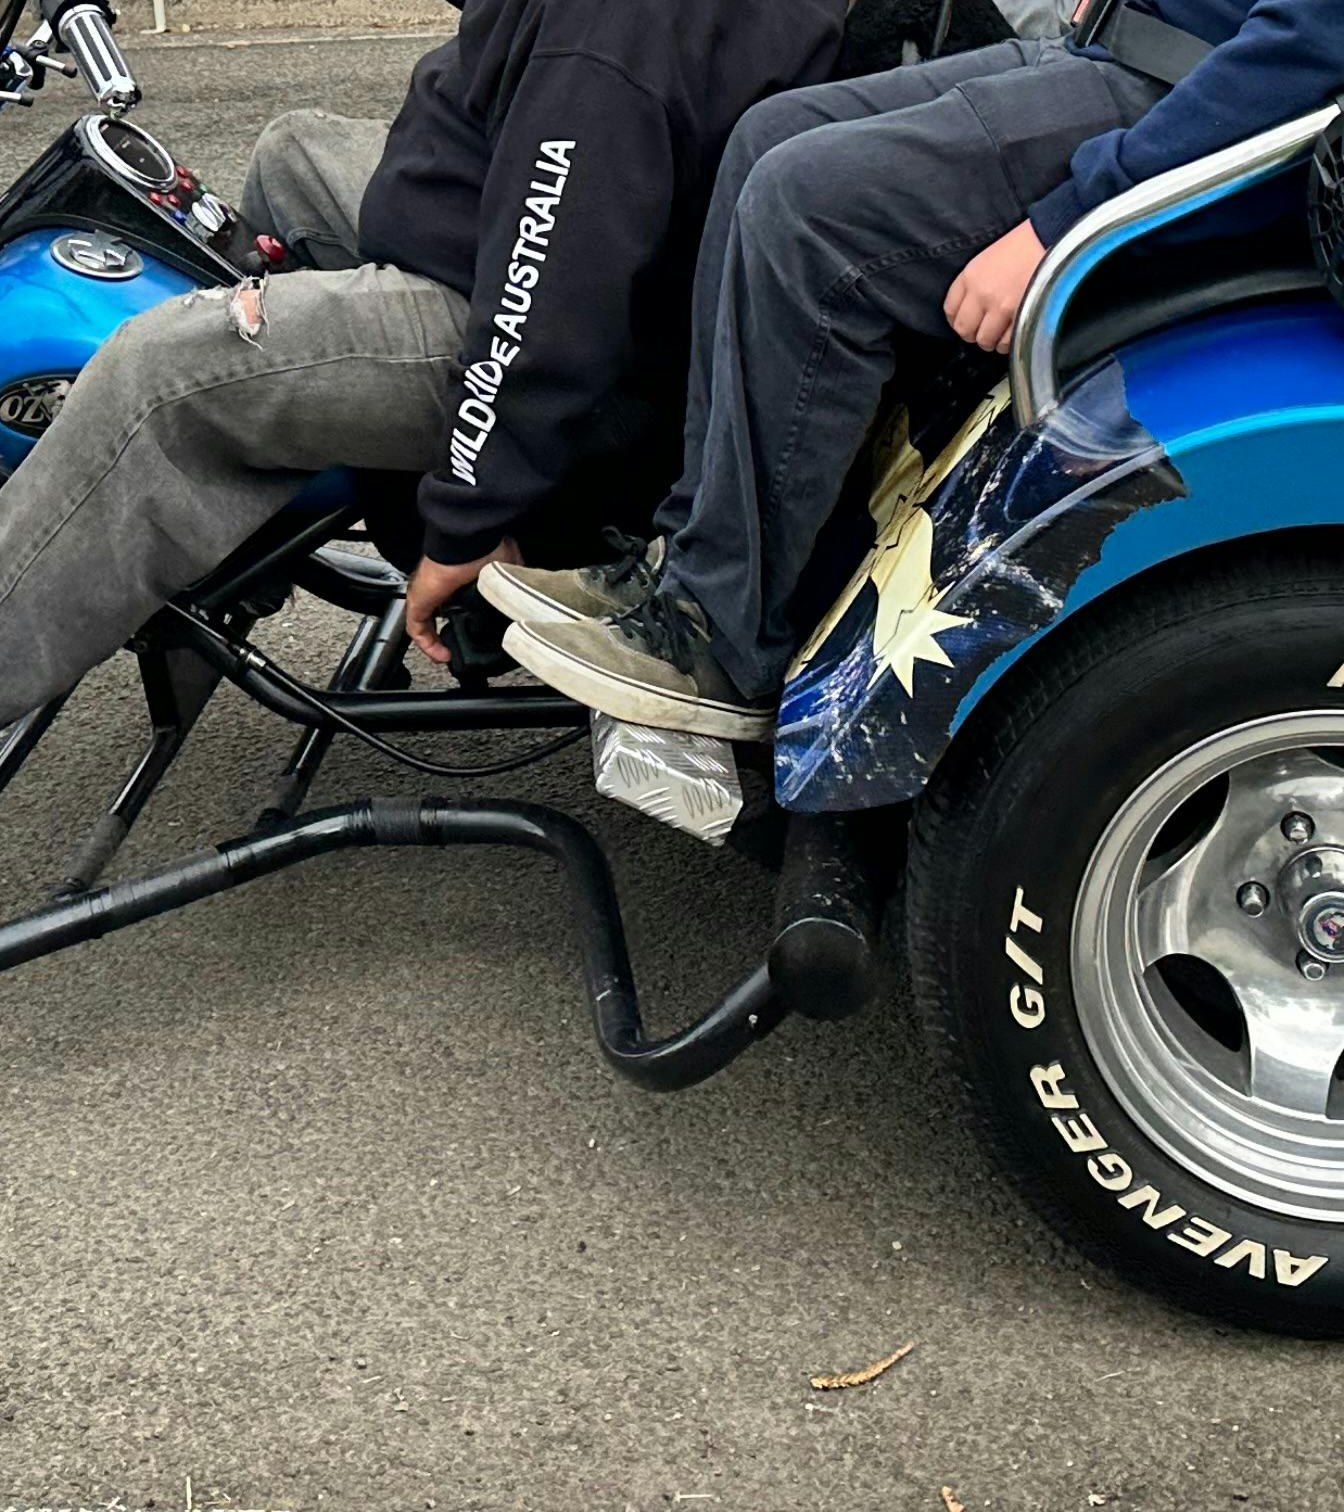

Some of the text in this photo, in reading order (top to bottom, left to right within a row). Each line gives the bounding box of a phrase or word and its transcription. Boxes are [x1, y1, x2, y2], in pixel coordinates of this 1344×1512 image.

[493, 140, 576, 341] AUSTRALIA
[1008, 886, 1332, 1288] AVENGER G/T
